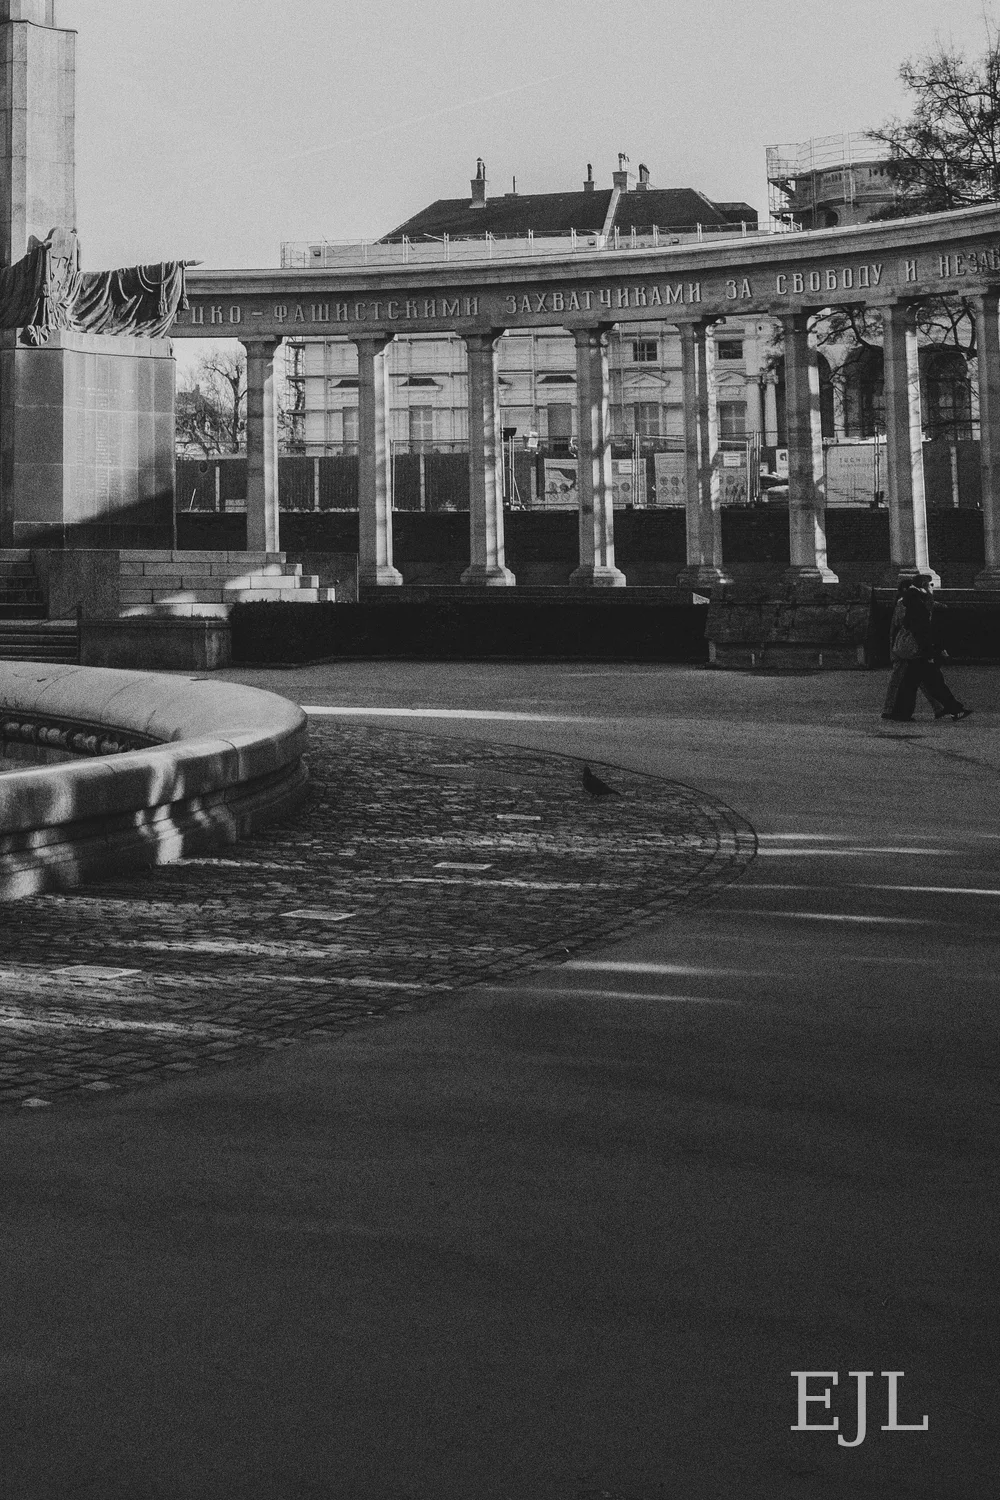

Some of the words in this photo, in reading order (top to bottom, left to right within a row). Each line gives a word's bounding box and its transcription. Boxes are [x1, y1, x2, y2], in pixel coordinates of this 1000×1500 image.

[505, 282, 702, 315] ЗАХВАТЧИКАМИ
[725, 277, 753, 300] ЗА
[776, 263, 883, 296] СВОБОДУ
[904, 259, 918, 283] И
